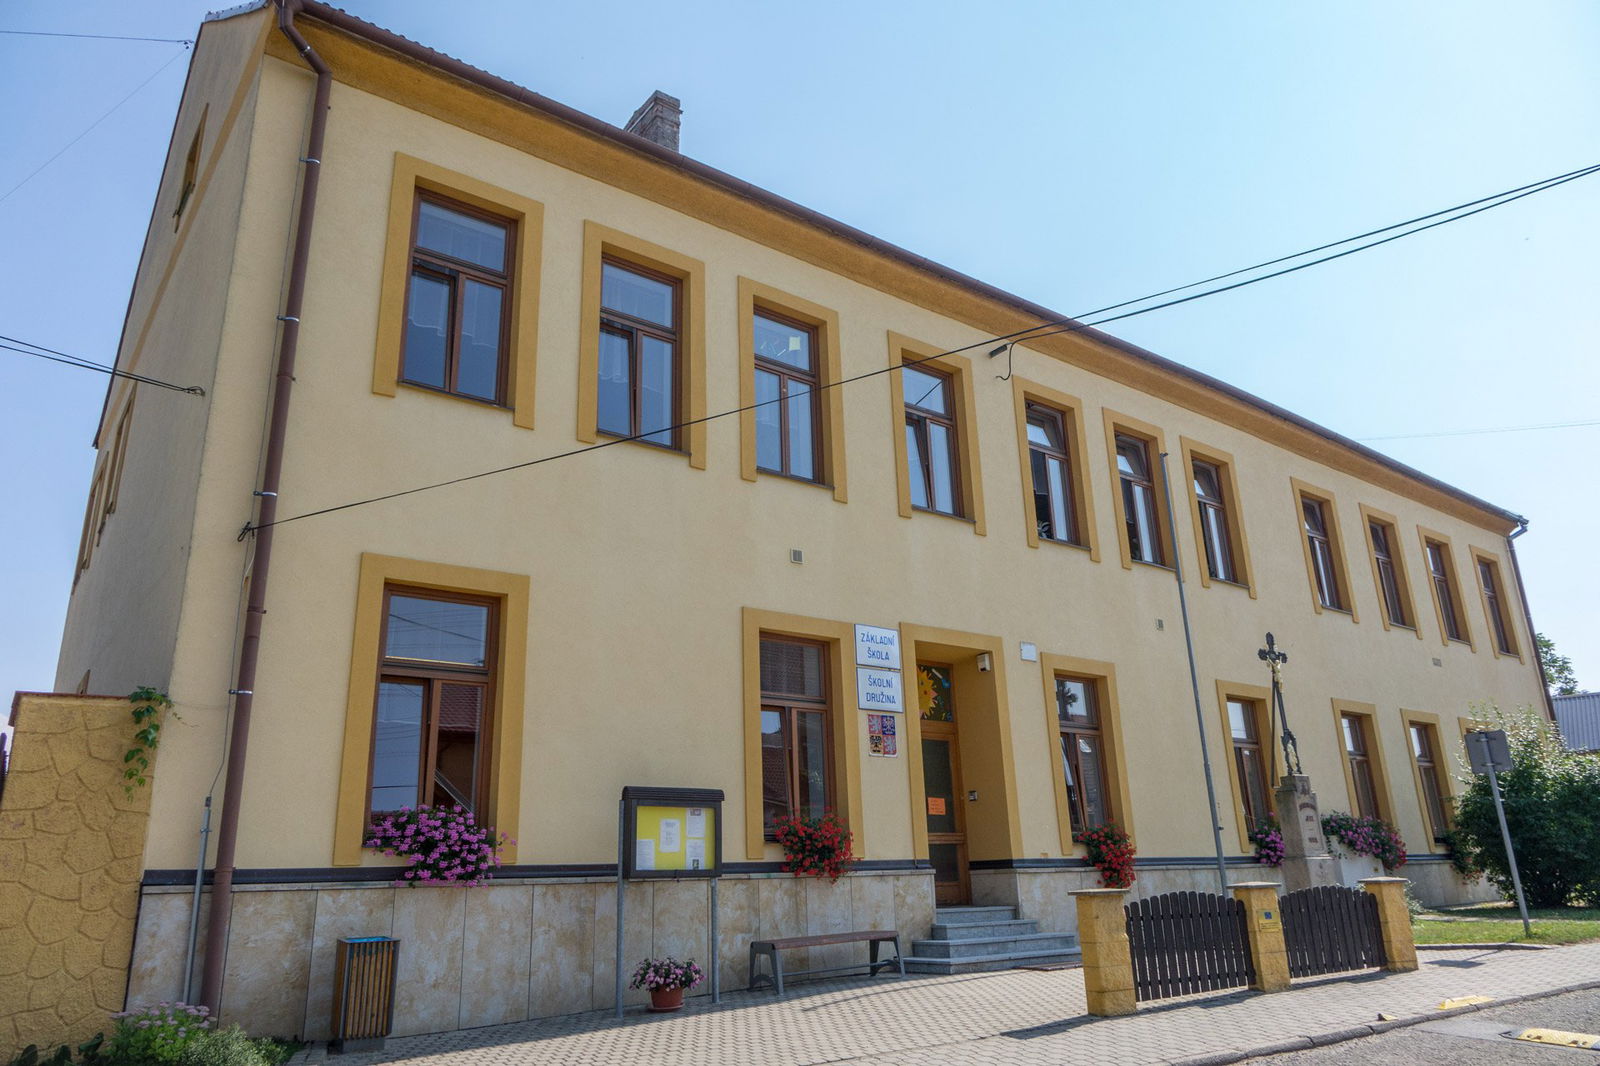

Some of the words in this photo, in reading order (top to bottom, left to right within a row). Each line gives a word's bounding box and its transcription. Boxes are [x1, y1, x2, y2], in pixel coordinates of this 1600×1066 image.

[860, 632, 895, 646] ZÁKLADNÍ
[867, 647, 890, 660] ŠKOLA
[868, 675, 893, 689] ŠKOLNÍ
[866, 692, 896, 704] DRUŽINA
